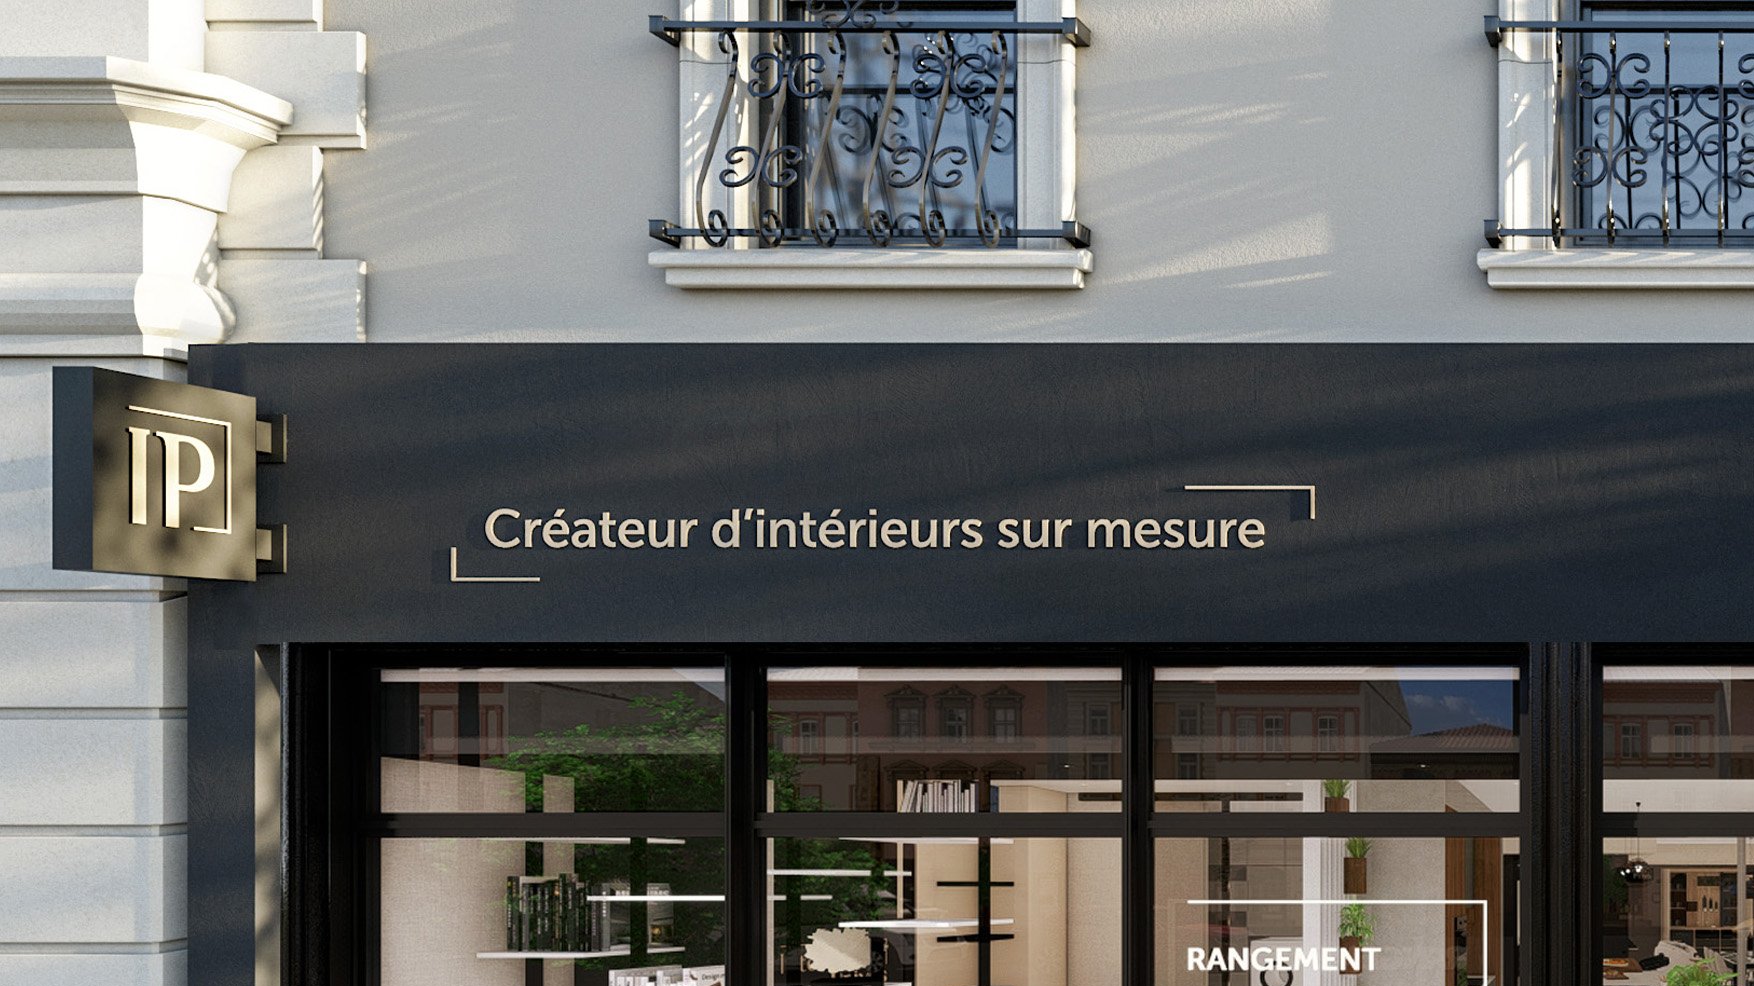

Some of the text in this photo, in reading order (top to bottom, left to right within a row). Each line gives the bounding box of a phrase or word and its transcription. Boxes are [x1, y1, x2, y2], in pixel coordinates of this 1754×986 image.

[127, 426, 216, 529] IP
[484, 507, 1266, 550] Créateur d'intérieurs sur mesure
[1187, 947, 1381, 972] RANGEMENT
